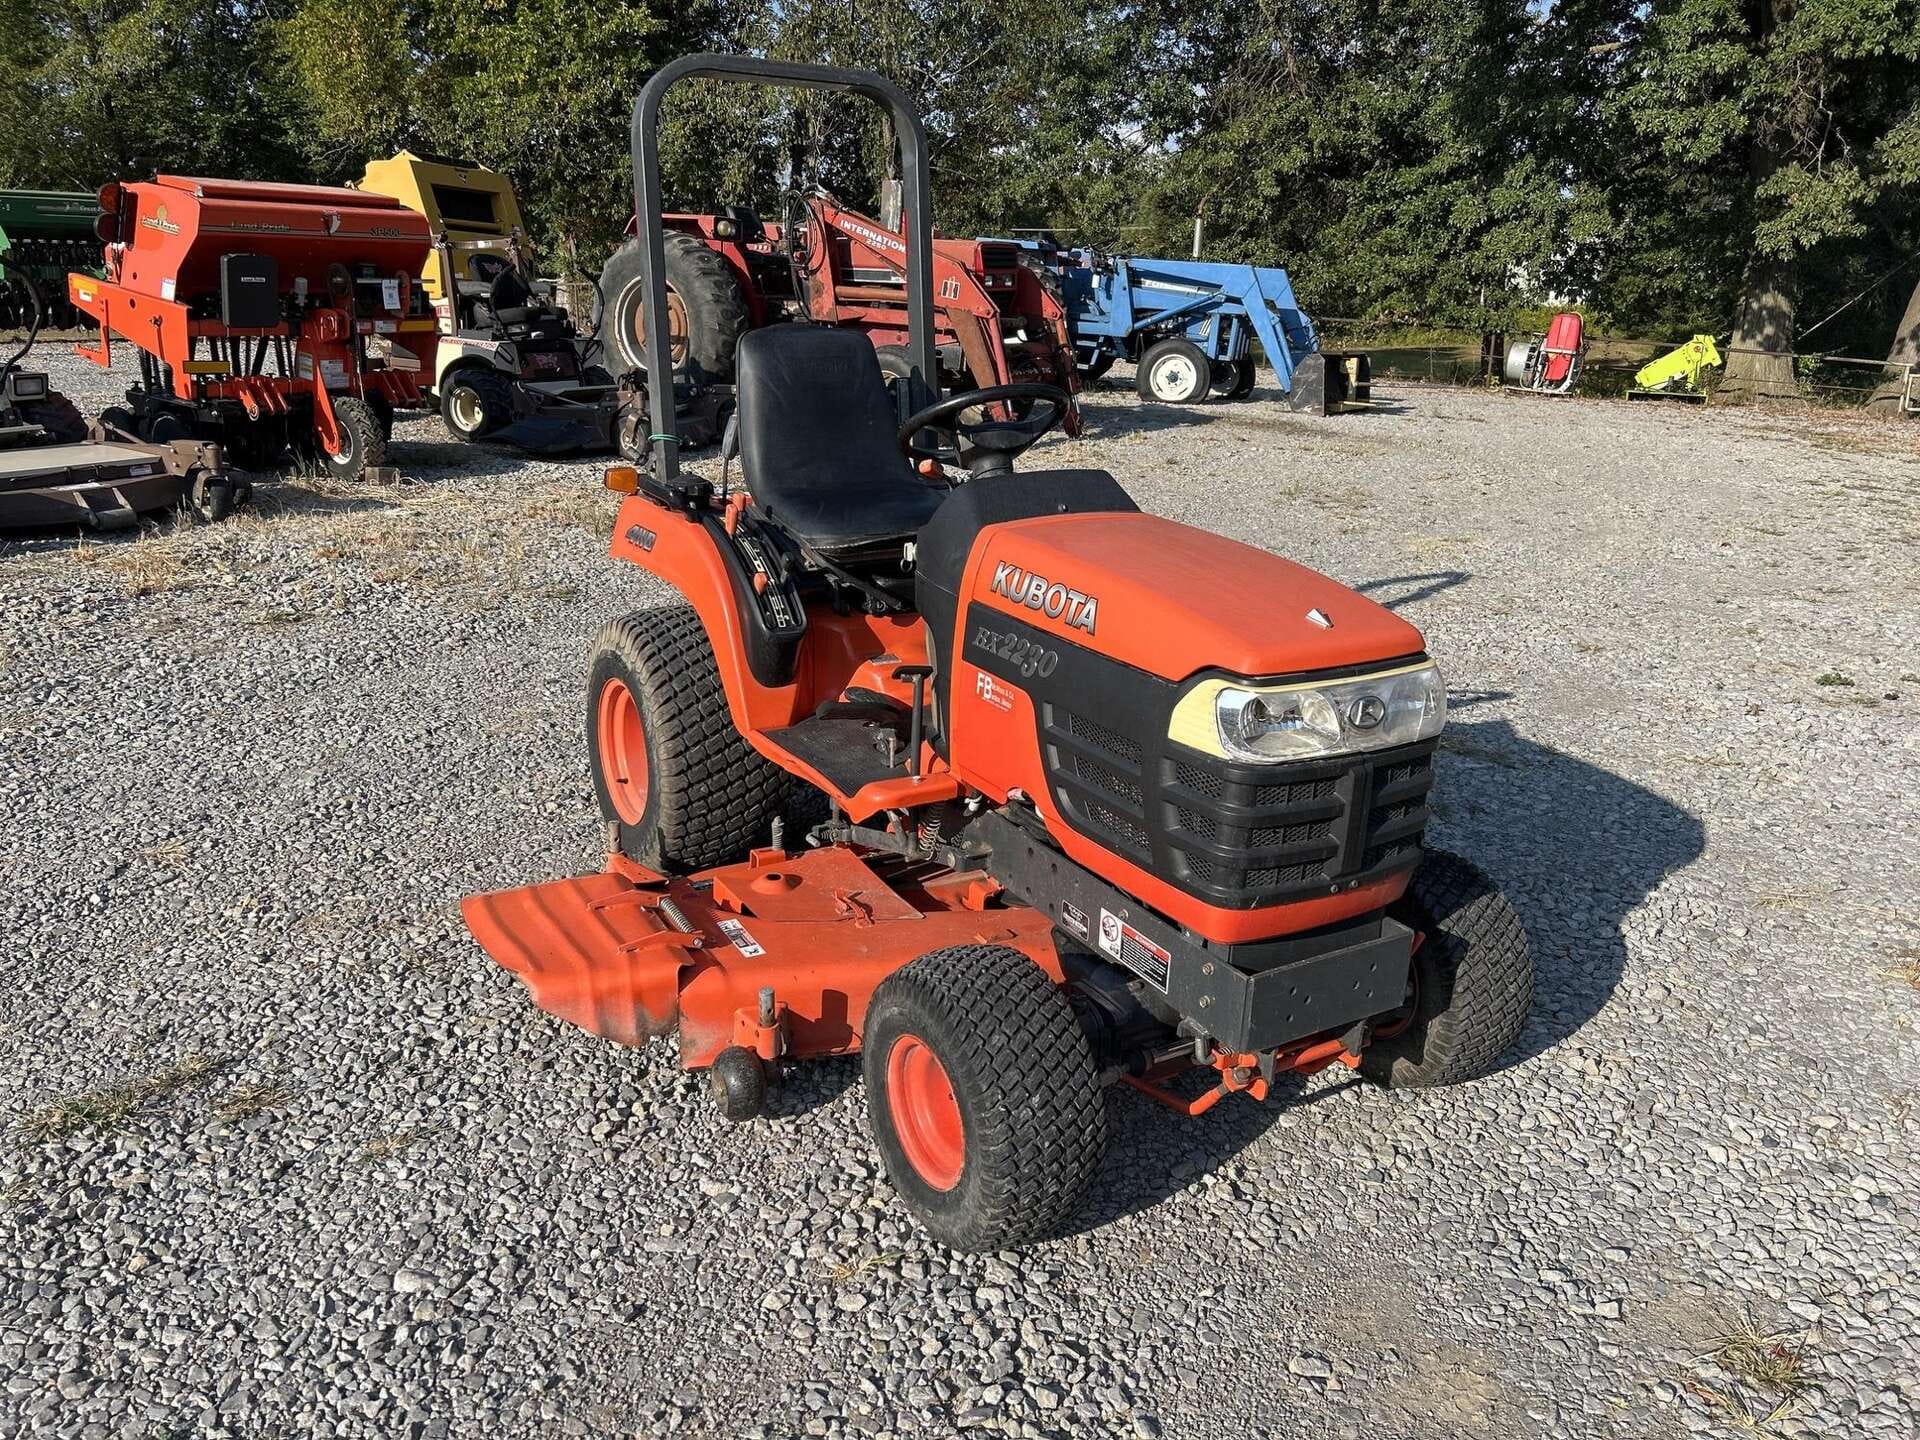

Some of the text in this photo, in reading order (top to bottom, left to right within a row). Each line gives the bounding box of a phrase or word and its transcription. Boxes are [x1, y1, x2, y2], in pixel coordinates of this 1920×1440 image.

[625, 524, 657, 552] 4WD
[990, 560, 1099, 636] KUBOTA
[972, 626, 1059, 678] BX2230
